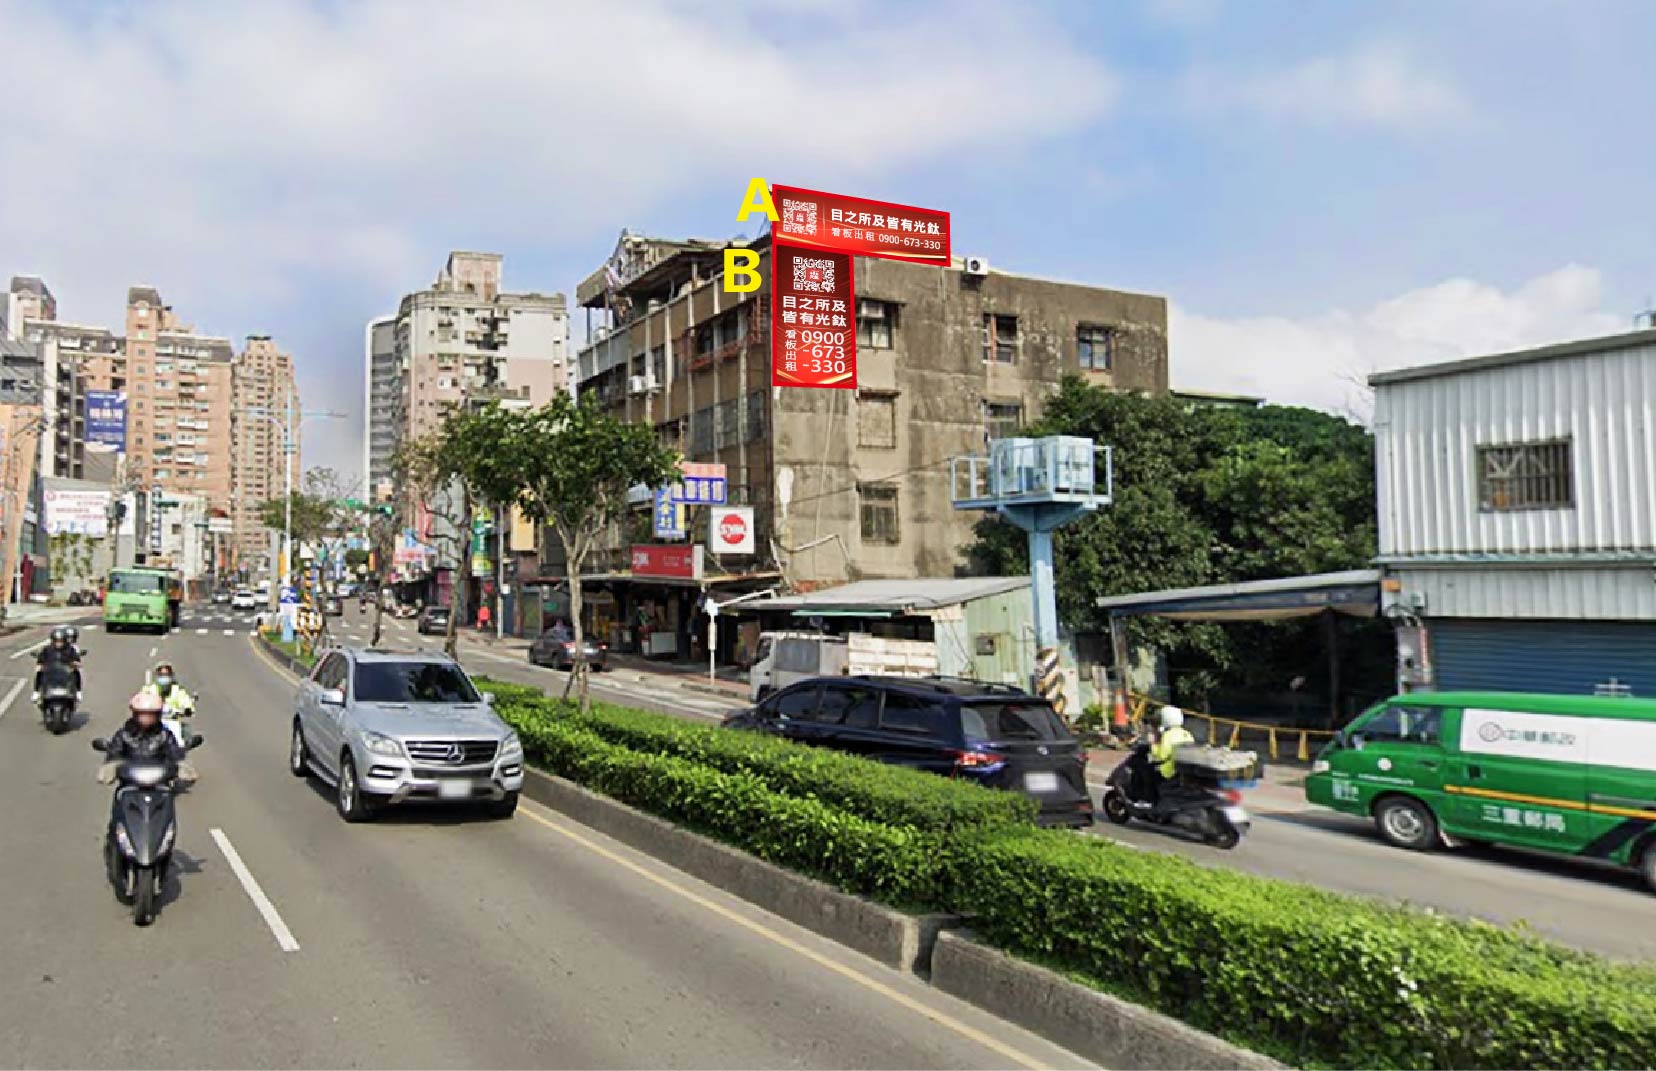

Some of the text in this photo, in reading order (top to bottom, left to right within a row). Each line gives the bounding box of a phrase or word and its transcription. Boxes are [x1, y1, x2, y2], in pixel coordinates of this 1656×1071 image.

[831, 208, 940, 235] 目之所及皆有光鈦
[831, 227, 941, 250] 看板出租 0900-673-330
[782, 295, 847, 313] 目之所及
[782, 310, 847, 327] 皆有光鈦
[801, 330, 845, 345] 0900
[785, 329, 797, 372] 看板出租
[802, 345, 845, 359] -673
[802, 359, 846, 374] -330
